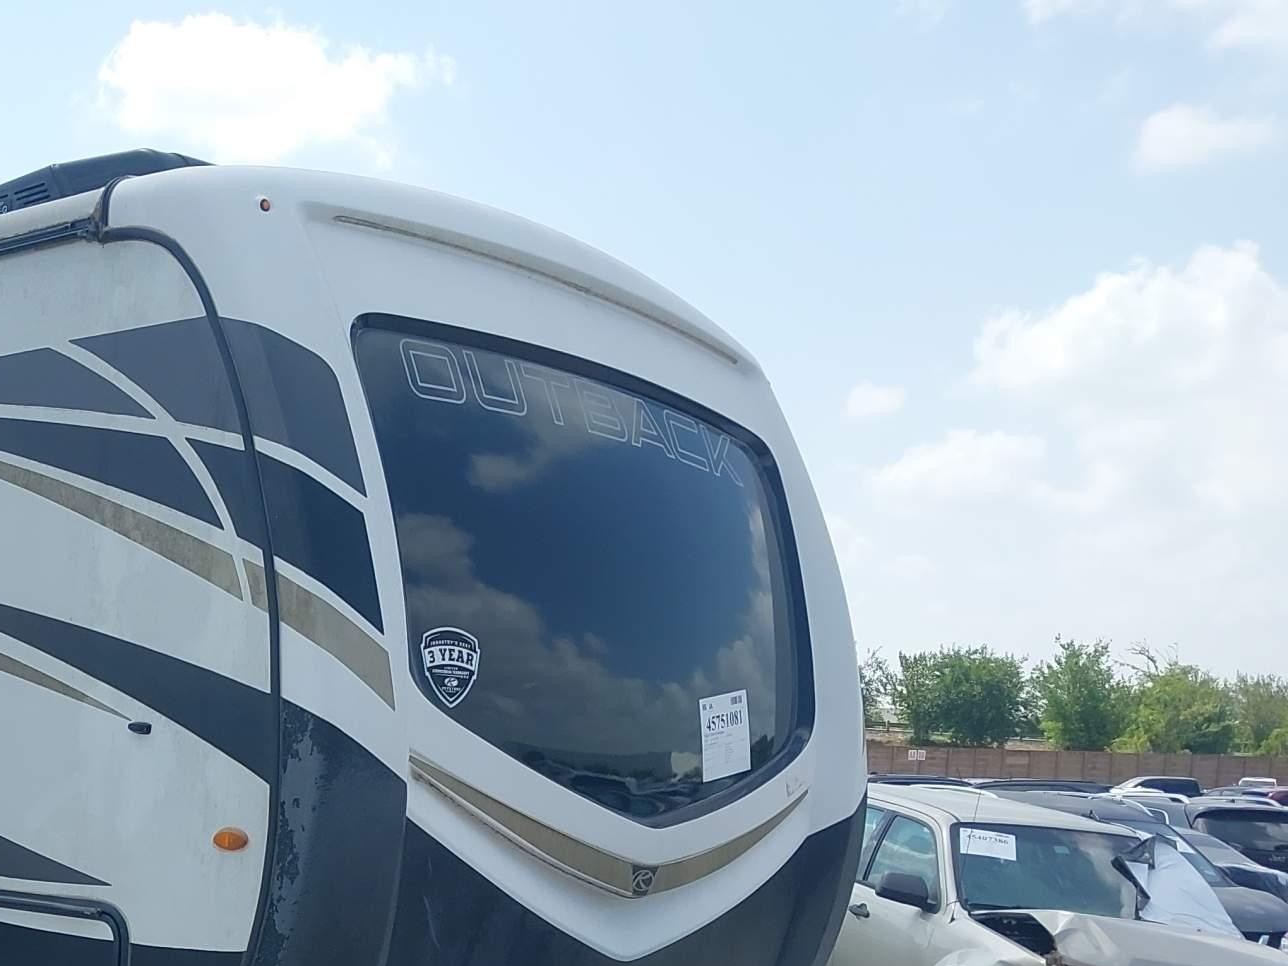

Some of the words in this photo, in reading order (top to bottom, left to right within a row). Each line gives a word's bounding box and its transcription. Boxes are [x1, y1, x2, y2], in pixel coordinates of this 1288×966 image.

[400, 338, 744, 487] OUTBACK
[427, 649, 436, 664] 3
[438, 648, 474, 667] YEAR
[706, 710, 743, 731] 45751081
